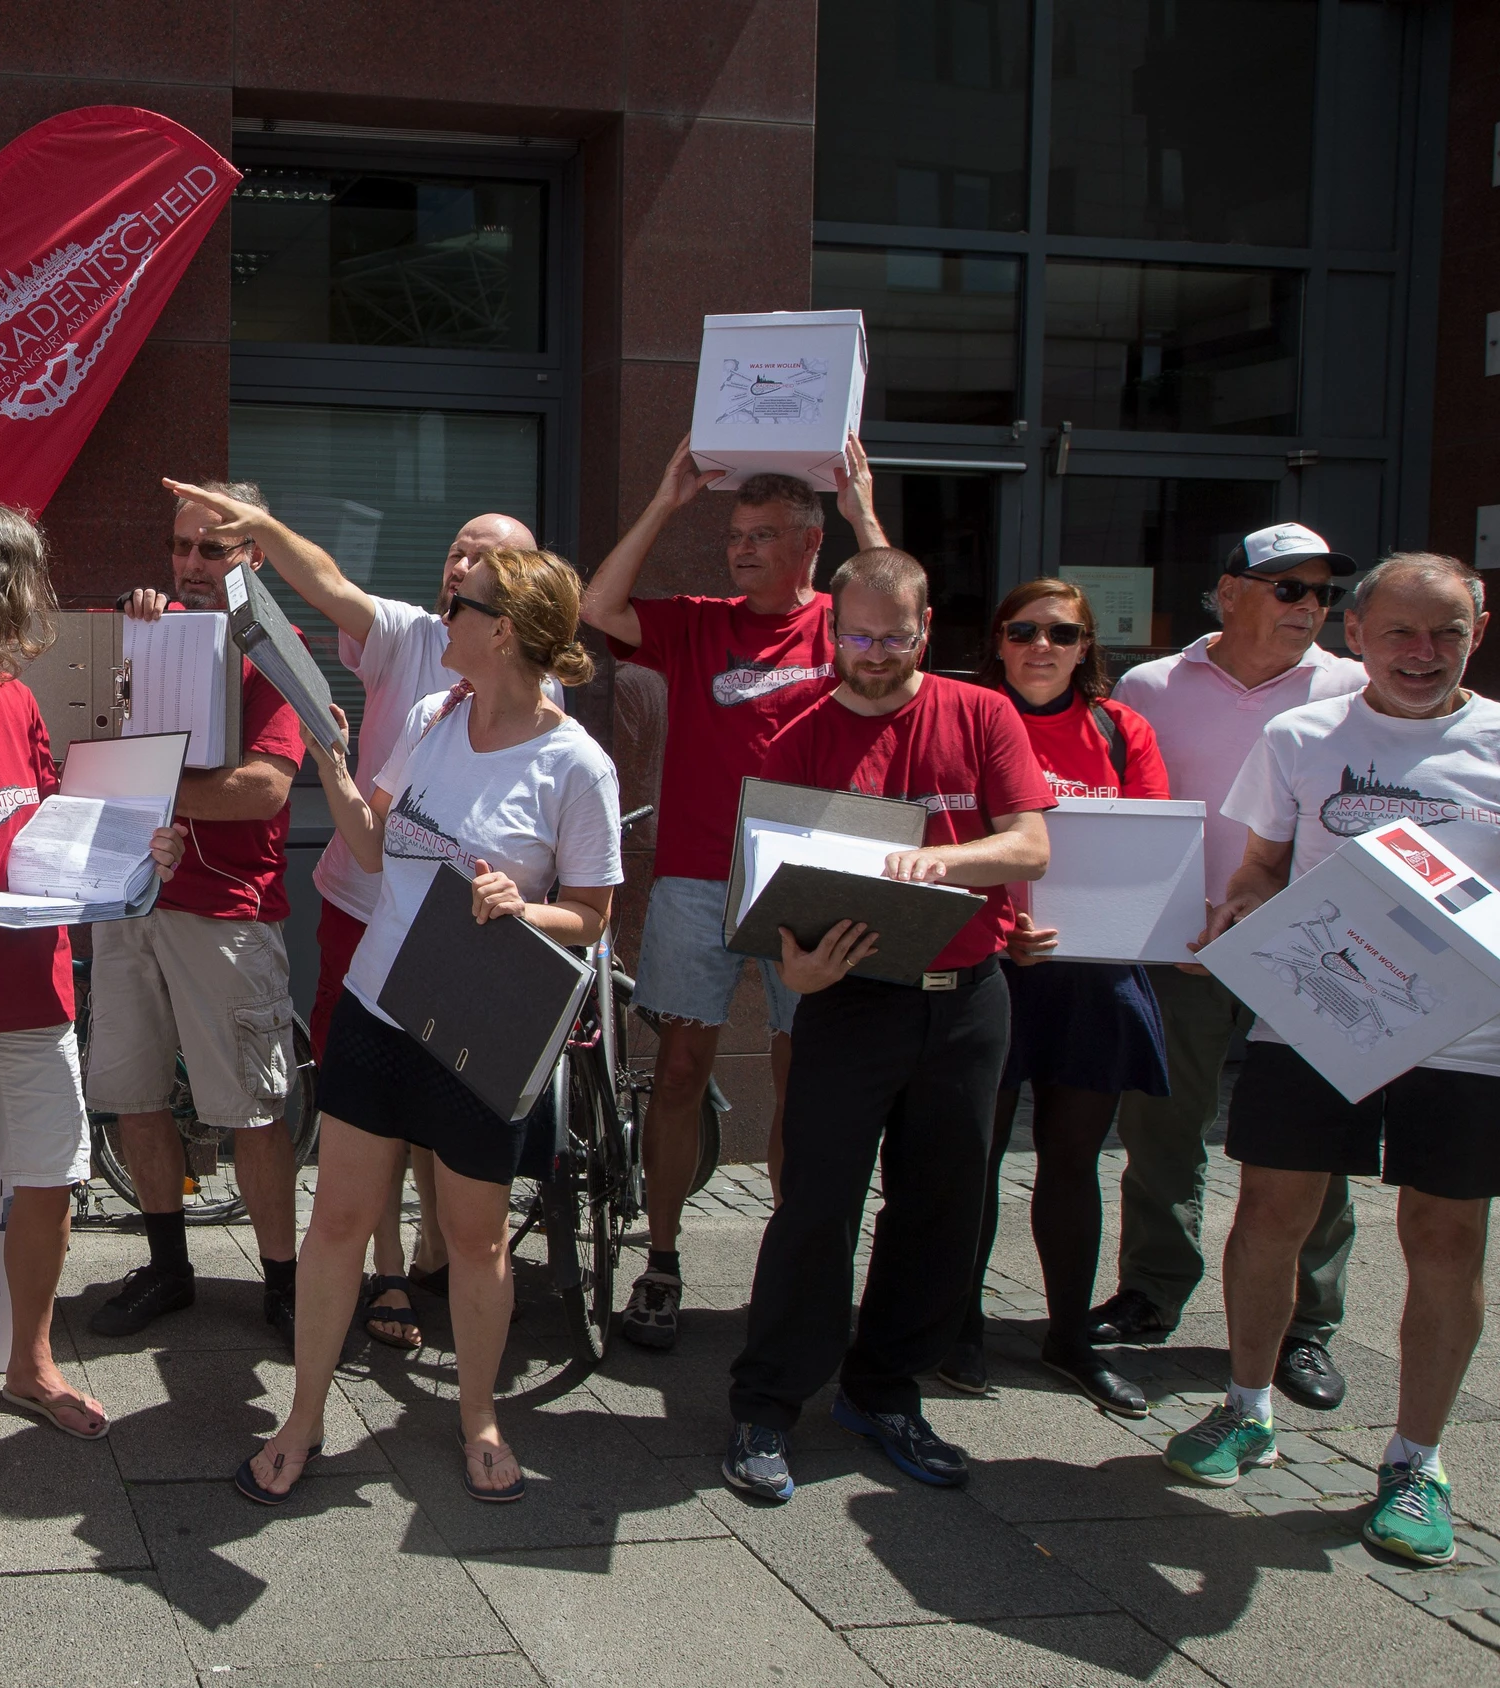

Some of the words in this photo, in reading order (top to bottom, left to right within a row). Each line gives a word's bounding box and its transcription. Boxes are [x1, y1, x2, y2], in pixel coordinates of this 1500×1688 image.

[66, 312, 89, 336] AM
[87, 280, 123, 315] MAIN
[1327, 810, 1376, 818] FRANKFURT
[1346, 929, 1365, 945] WAS
[1363, 943, 1380, 956] WIR
[1377, 955, 1410, 982] WOLLEN
